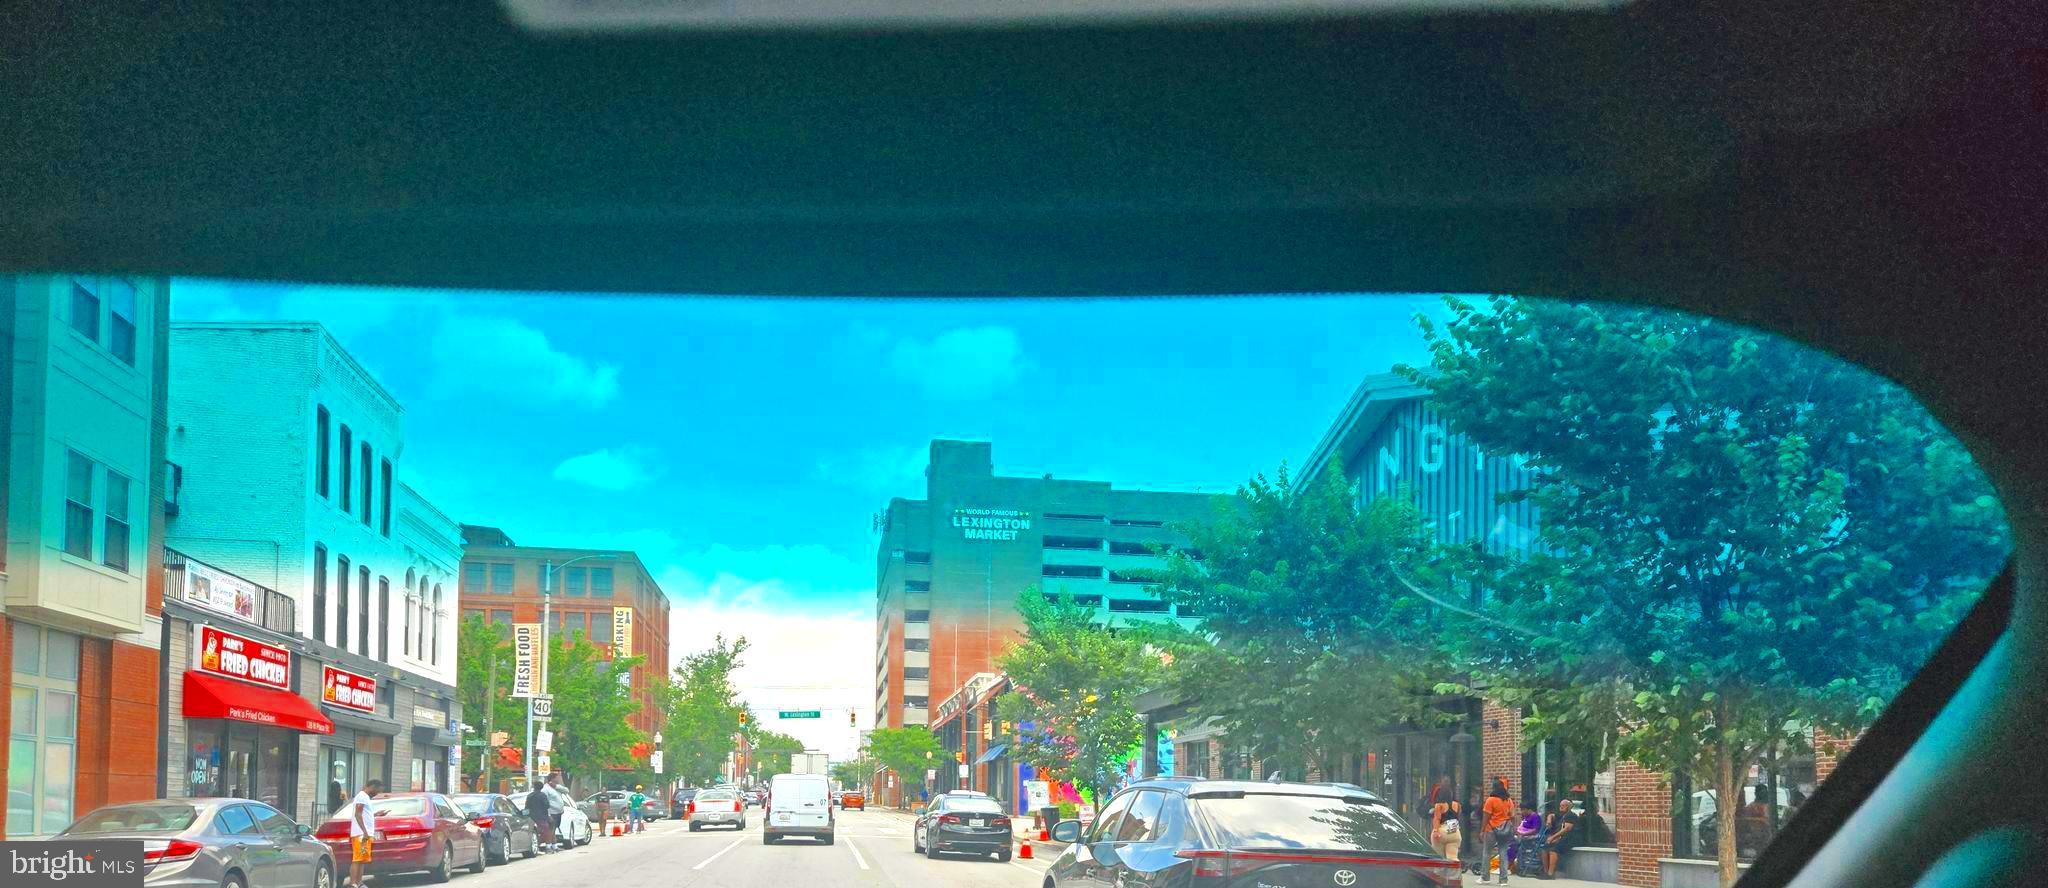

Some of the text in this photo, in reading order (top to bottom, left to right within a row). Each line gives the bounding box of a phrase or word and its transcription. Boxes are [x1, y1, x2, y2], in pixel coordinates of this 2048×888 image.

[953, 516, 1030, 530] LEXINGTON
[964, 528, 1018, 540] MARKET
[615, 610, 624, 656] ARKING
[220, 650, 249, 676] FRIED
[250, 657, 286, 684] CHICKEN
[517, 627, 530, 694] FRESH FOOD
[336, 684, 352, 704] FRIED
[352, 688, 374, 708] CHICKEN
[229, 707, 276, 722] Park's Fried Chicken
[535, 702, 549, 713] 40
